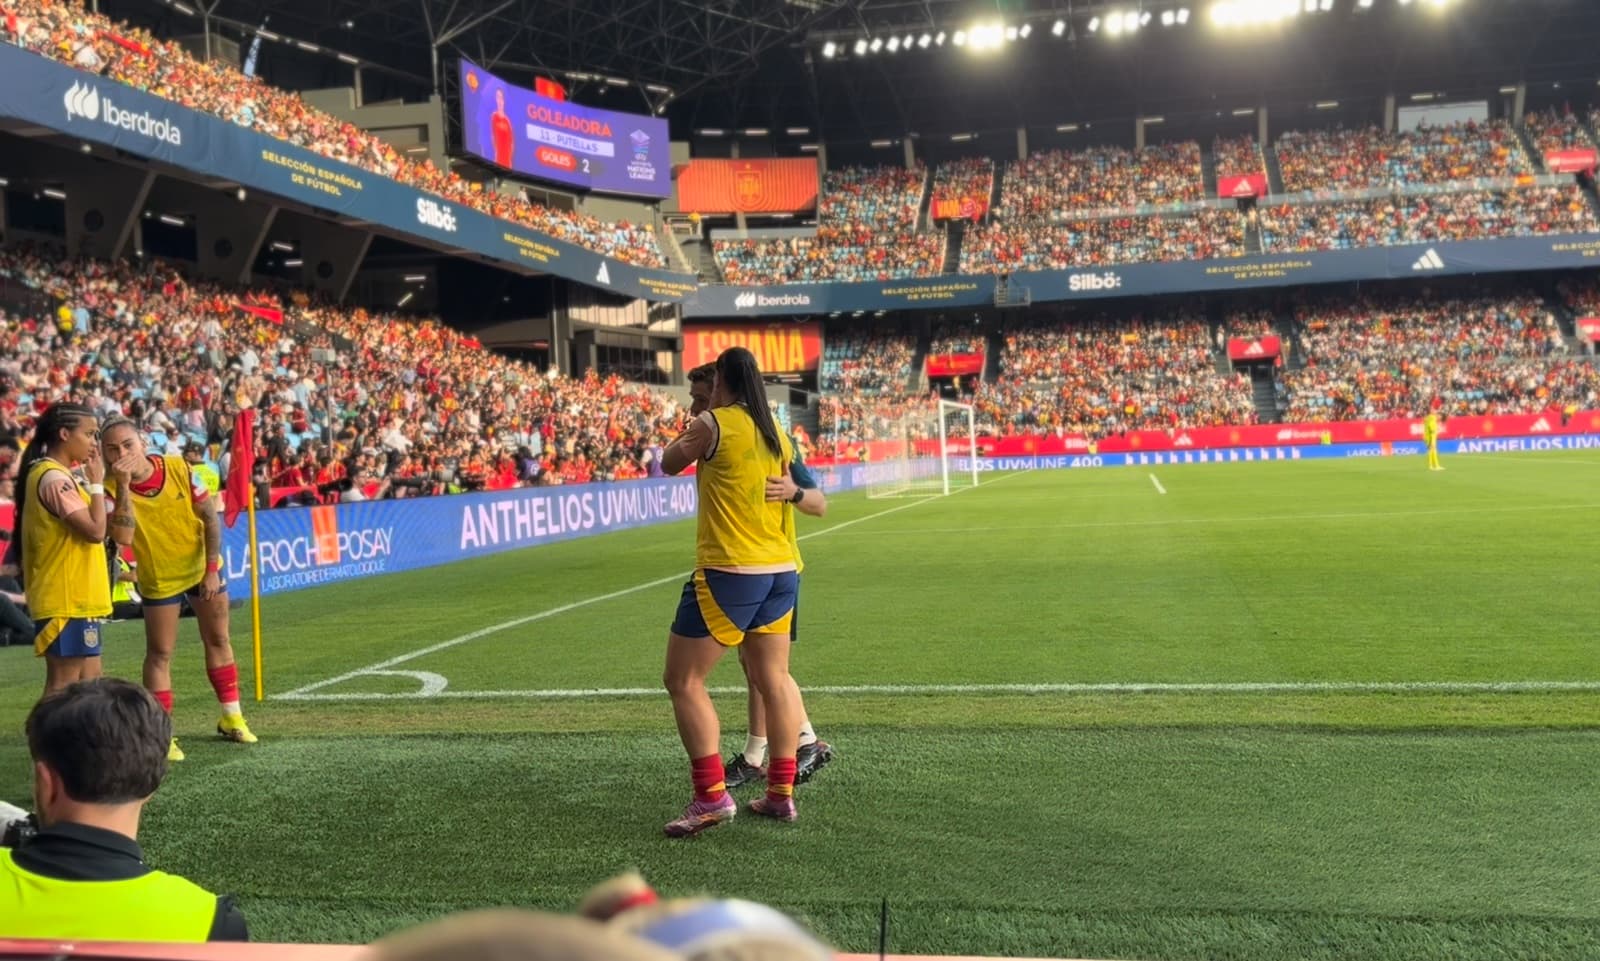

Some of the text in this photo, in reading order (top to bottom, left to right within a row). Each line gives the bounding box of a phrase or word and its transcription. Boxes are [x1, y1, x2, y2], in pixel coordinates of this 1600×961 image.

[102, 96, 182, 145] Iberdrola
[527, 103, 613, 138] GOLEADORA
[556, 134, 599, 153] PUTELLAS
[262, 149, 363, 192] SELECCIÓN ESPAÑOLA
[541, 150, 591, 174] GOLES 2
[291, 173, 342, 196] DE FÚTBOL
[1205, 260, 1313, 274] SELECCIÓN ESPAÑOLA
[758, 293, 811, 307] Iberdrola
[881, 282, 978, 295] SELECCIÓN ESPAÑOLA
[1456, 435, 1564, 454] ANTHELIOS
[1070, 455, 1104, 468] 400
[460, 482, 696, 550] ANTHELIOS UVMUNE 400
[336, 526, 394, 566] POSAY
